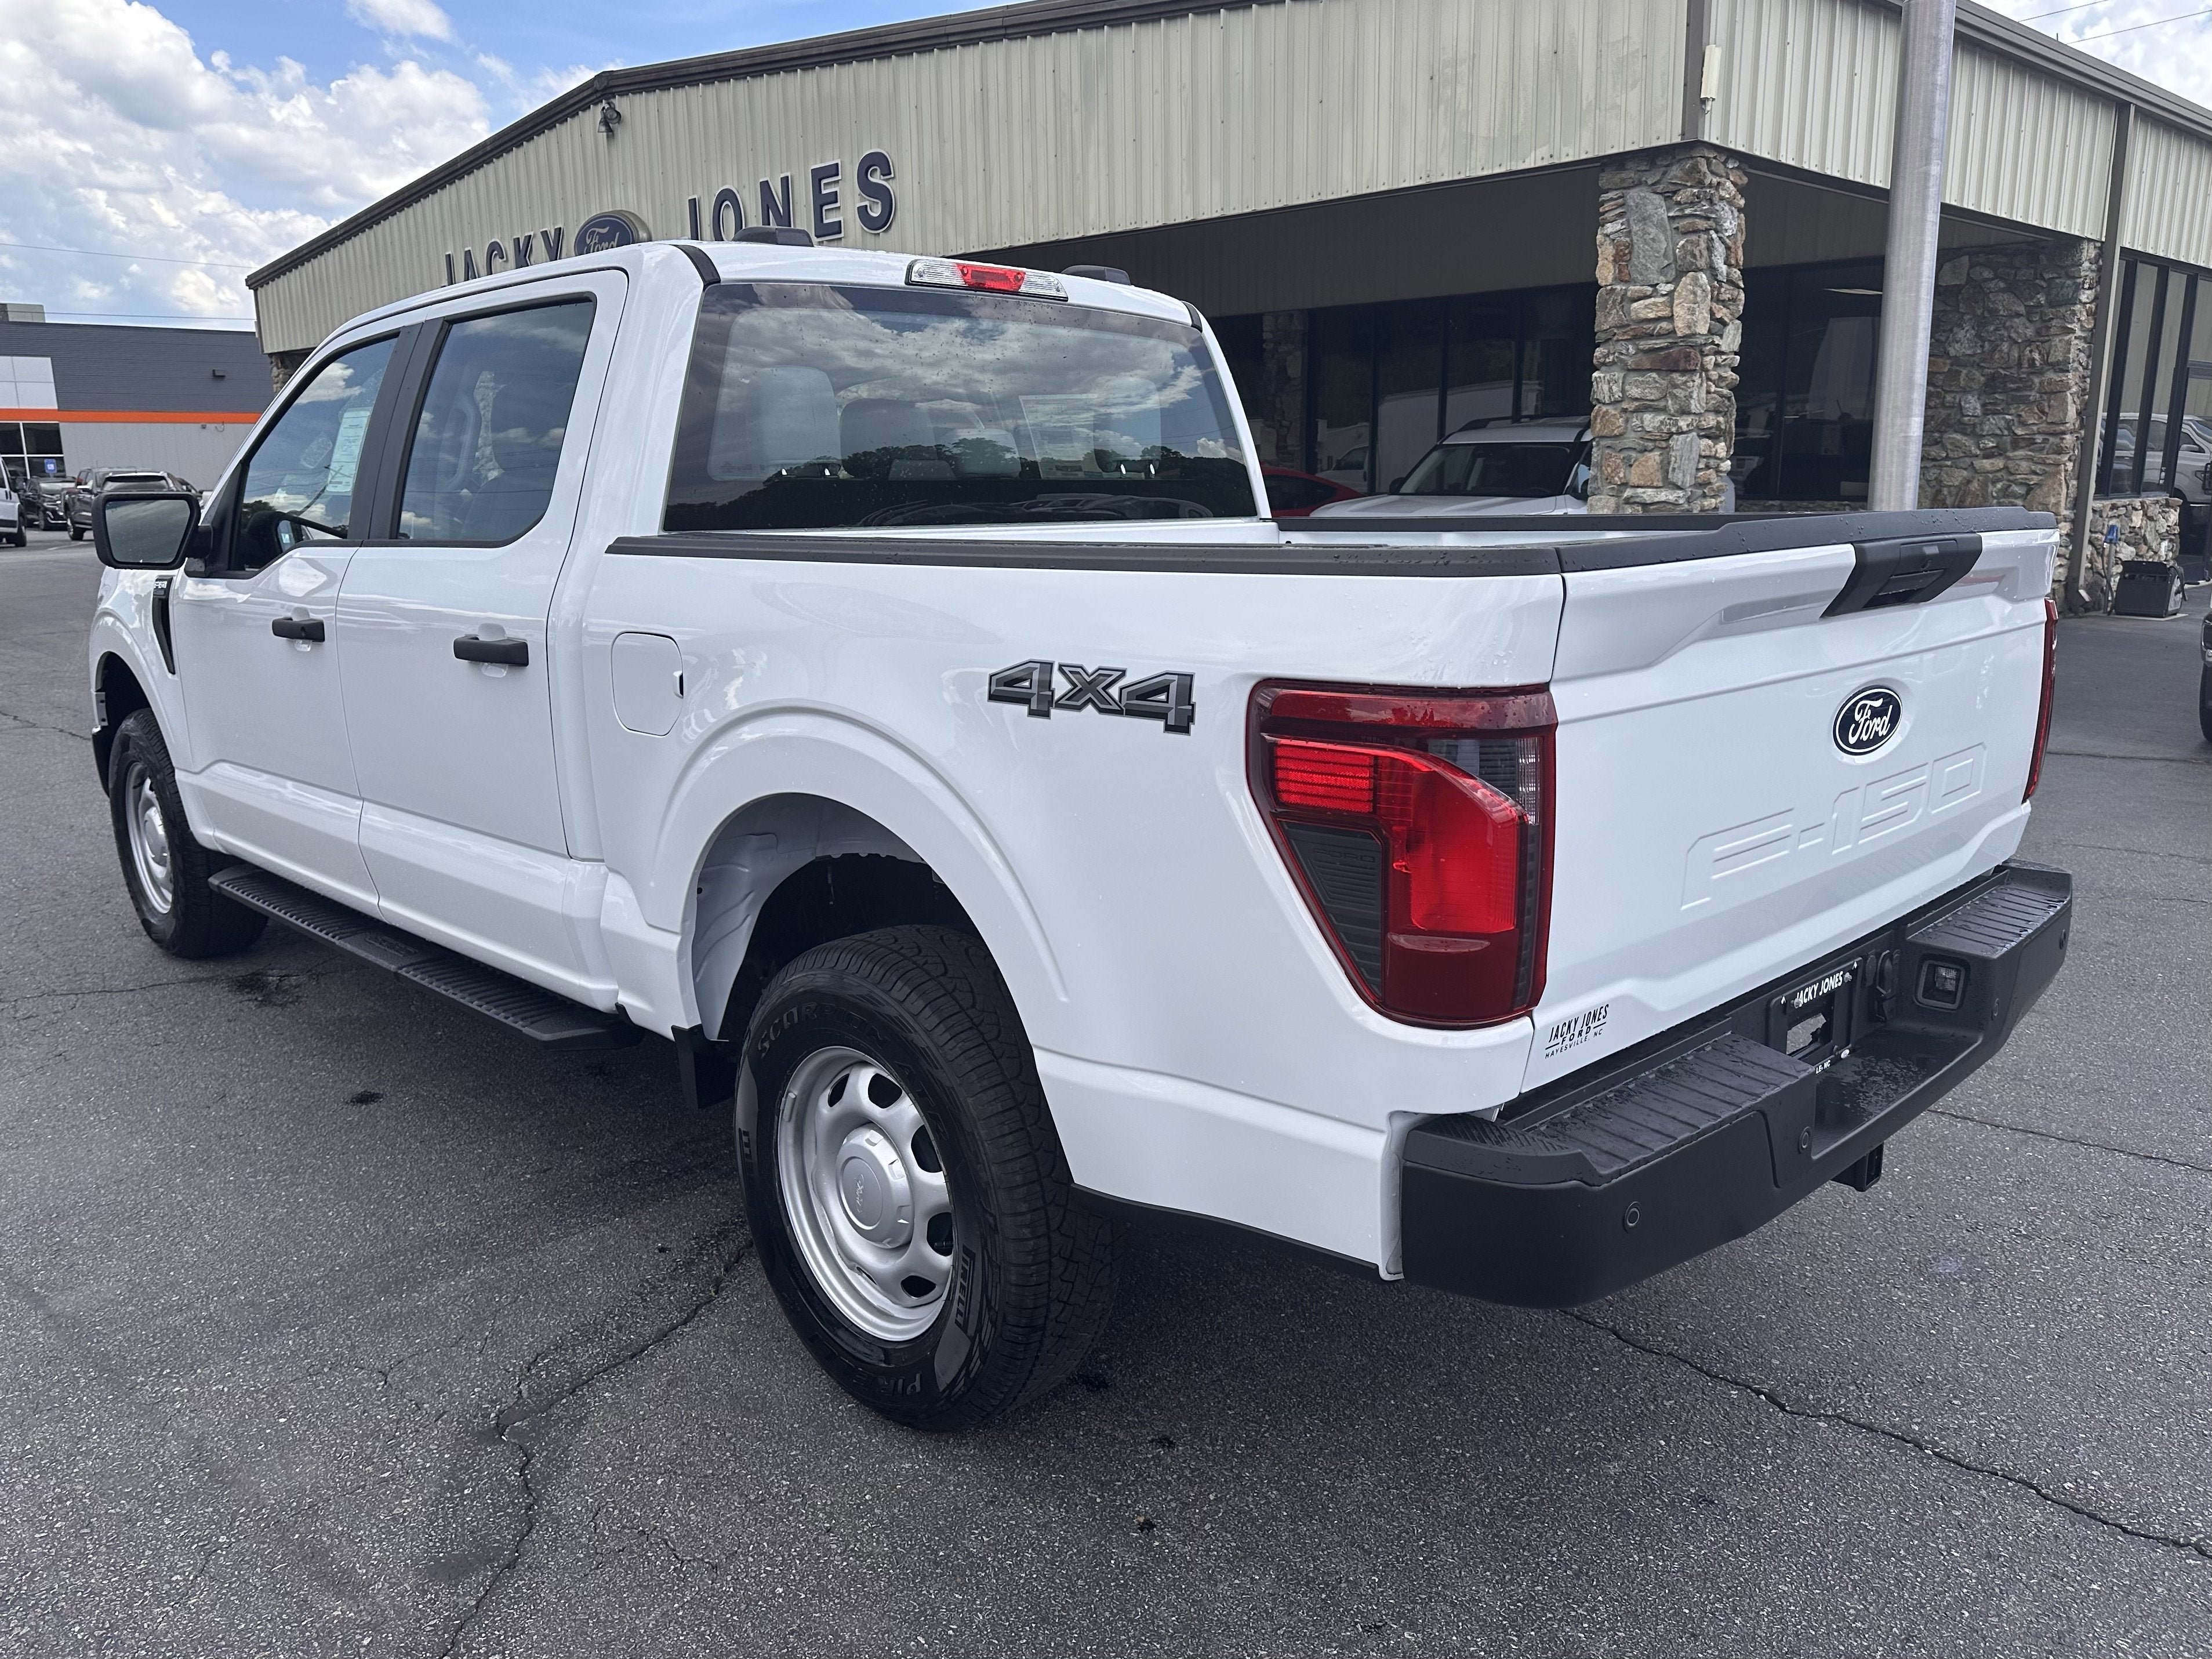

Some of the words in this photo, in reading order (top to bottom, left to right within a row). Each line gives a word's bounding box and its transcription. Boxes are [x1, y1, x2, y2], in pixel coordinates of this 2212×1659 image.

[440, 224, 564, 288] JACKY
[682, 148, 894, 242] JONES
[1848, 698, 1893, 745] Ford
[1680, 741, 1988, 911] F-150
[1819, 971, 1844, 996] JONES
[1548, 1016, 1579, 1043] JACKY
[1581, 1003, 1610, 1029] JONES
[1561, 1025, 1592, 1046] FORD
[1593, 1028, 1603, 1038] NC
